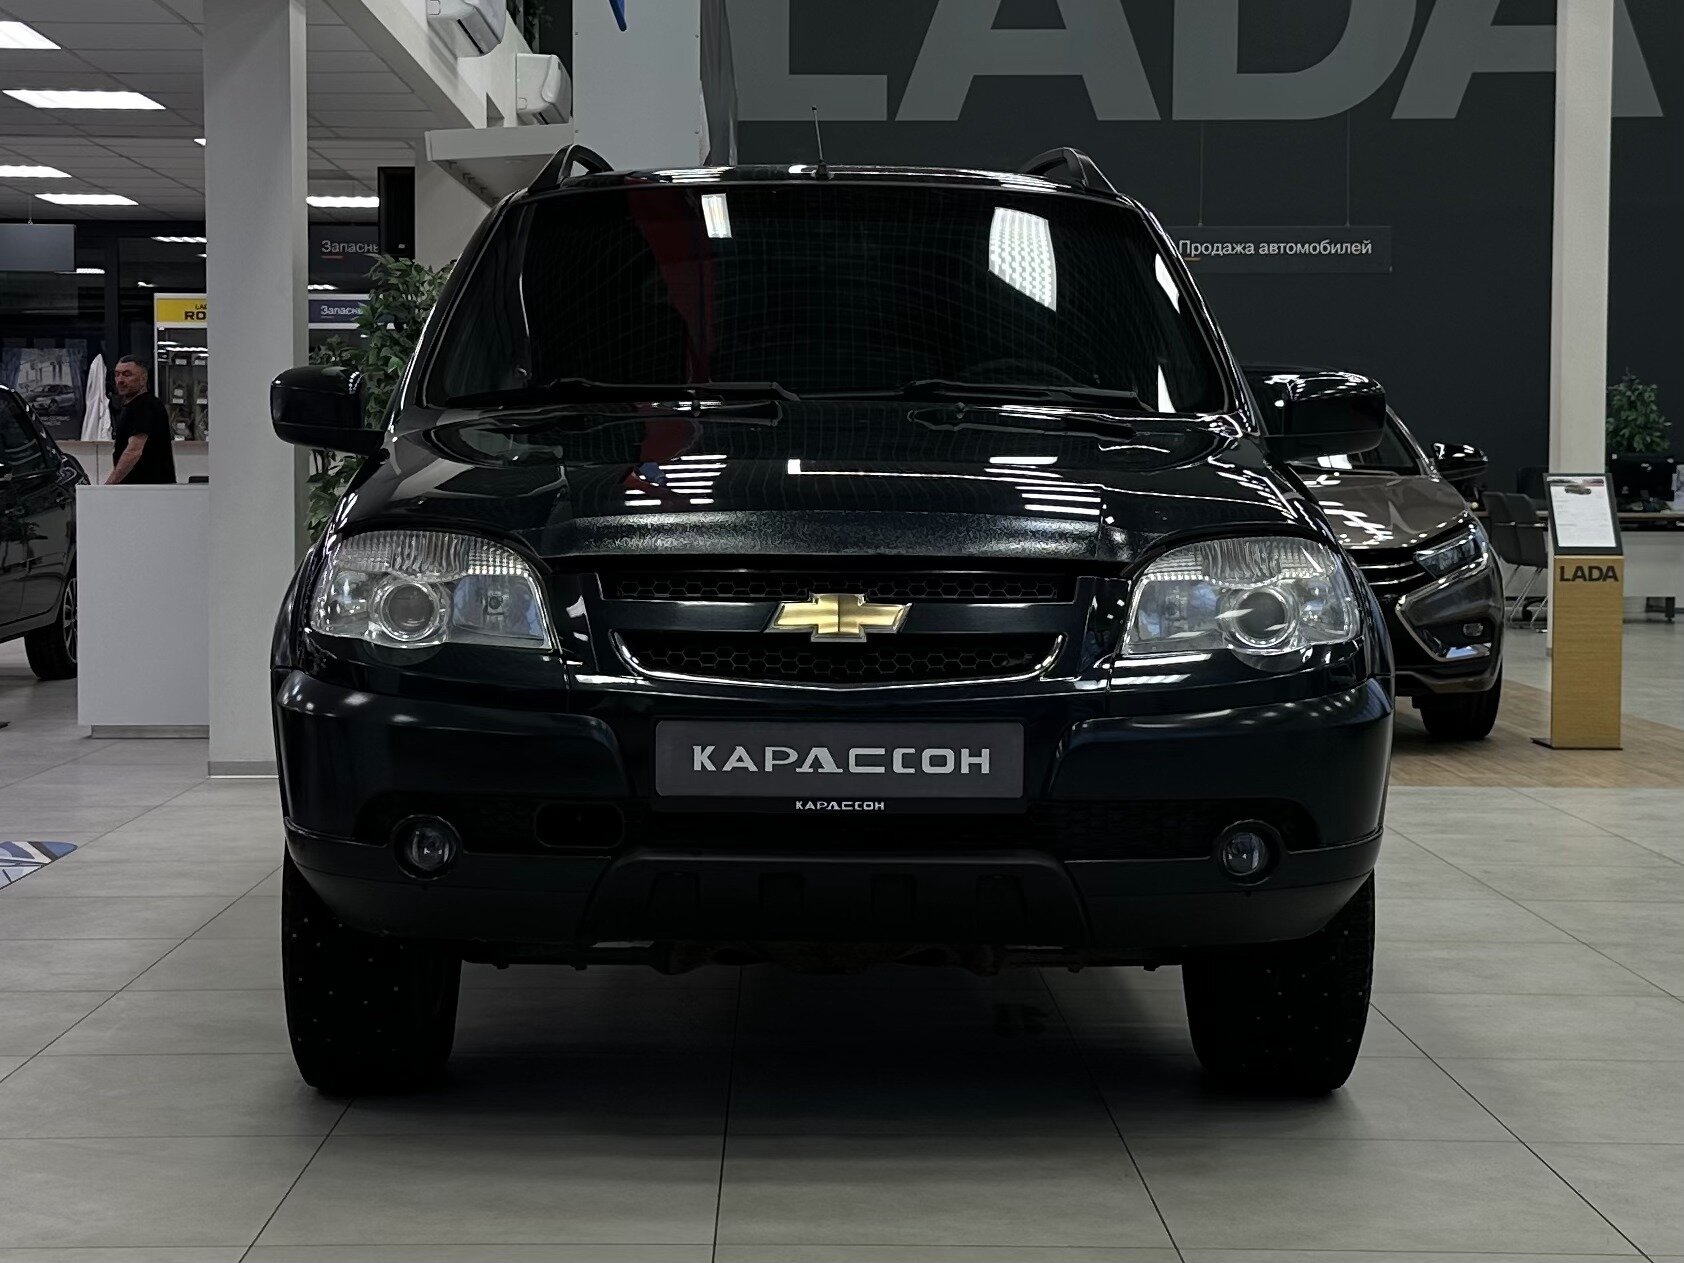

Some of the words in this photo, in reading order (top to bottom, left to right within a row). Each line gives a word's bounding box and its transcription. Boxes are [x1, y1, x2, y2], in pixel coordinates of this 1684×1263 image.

[737, 0, 1664, 121] LADA
[1179, 239, 1254, 257] Продажа
[1259, 239, 1372, 255] автомобилей
[1559, 565, 1619, 582] LADA
